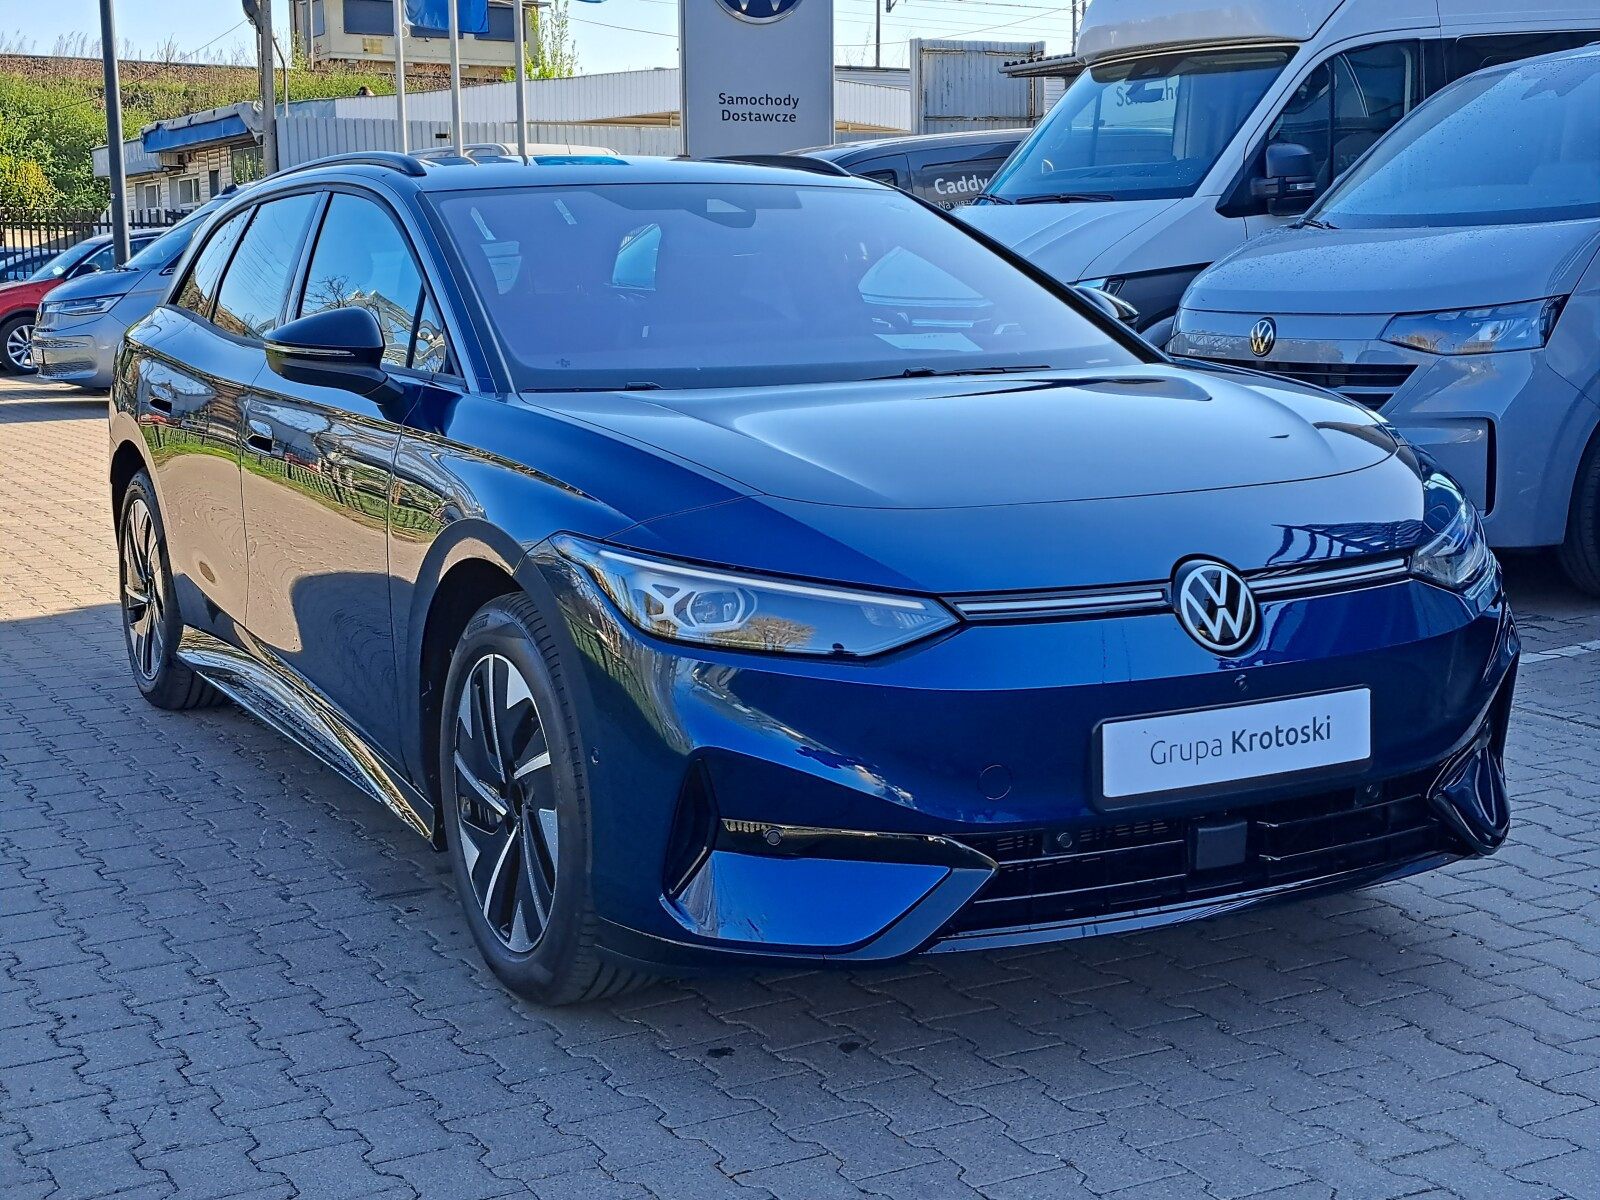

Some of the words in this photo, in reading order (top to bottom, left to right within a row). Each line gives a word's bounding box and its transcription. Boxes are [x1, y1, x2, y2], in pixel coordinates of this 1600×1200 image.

[718, 92, 800, 109] Samochody
[721, 109, 797, 122] Dostawcze
[934, 174, 988, 195] Caddy
[1181, 565, 1256, 651] VW
[1150, 738, 1223, 765] Grupa
[1231, 715, 1331, 754] Krotoski
